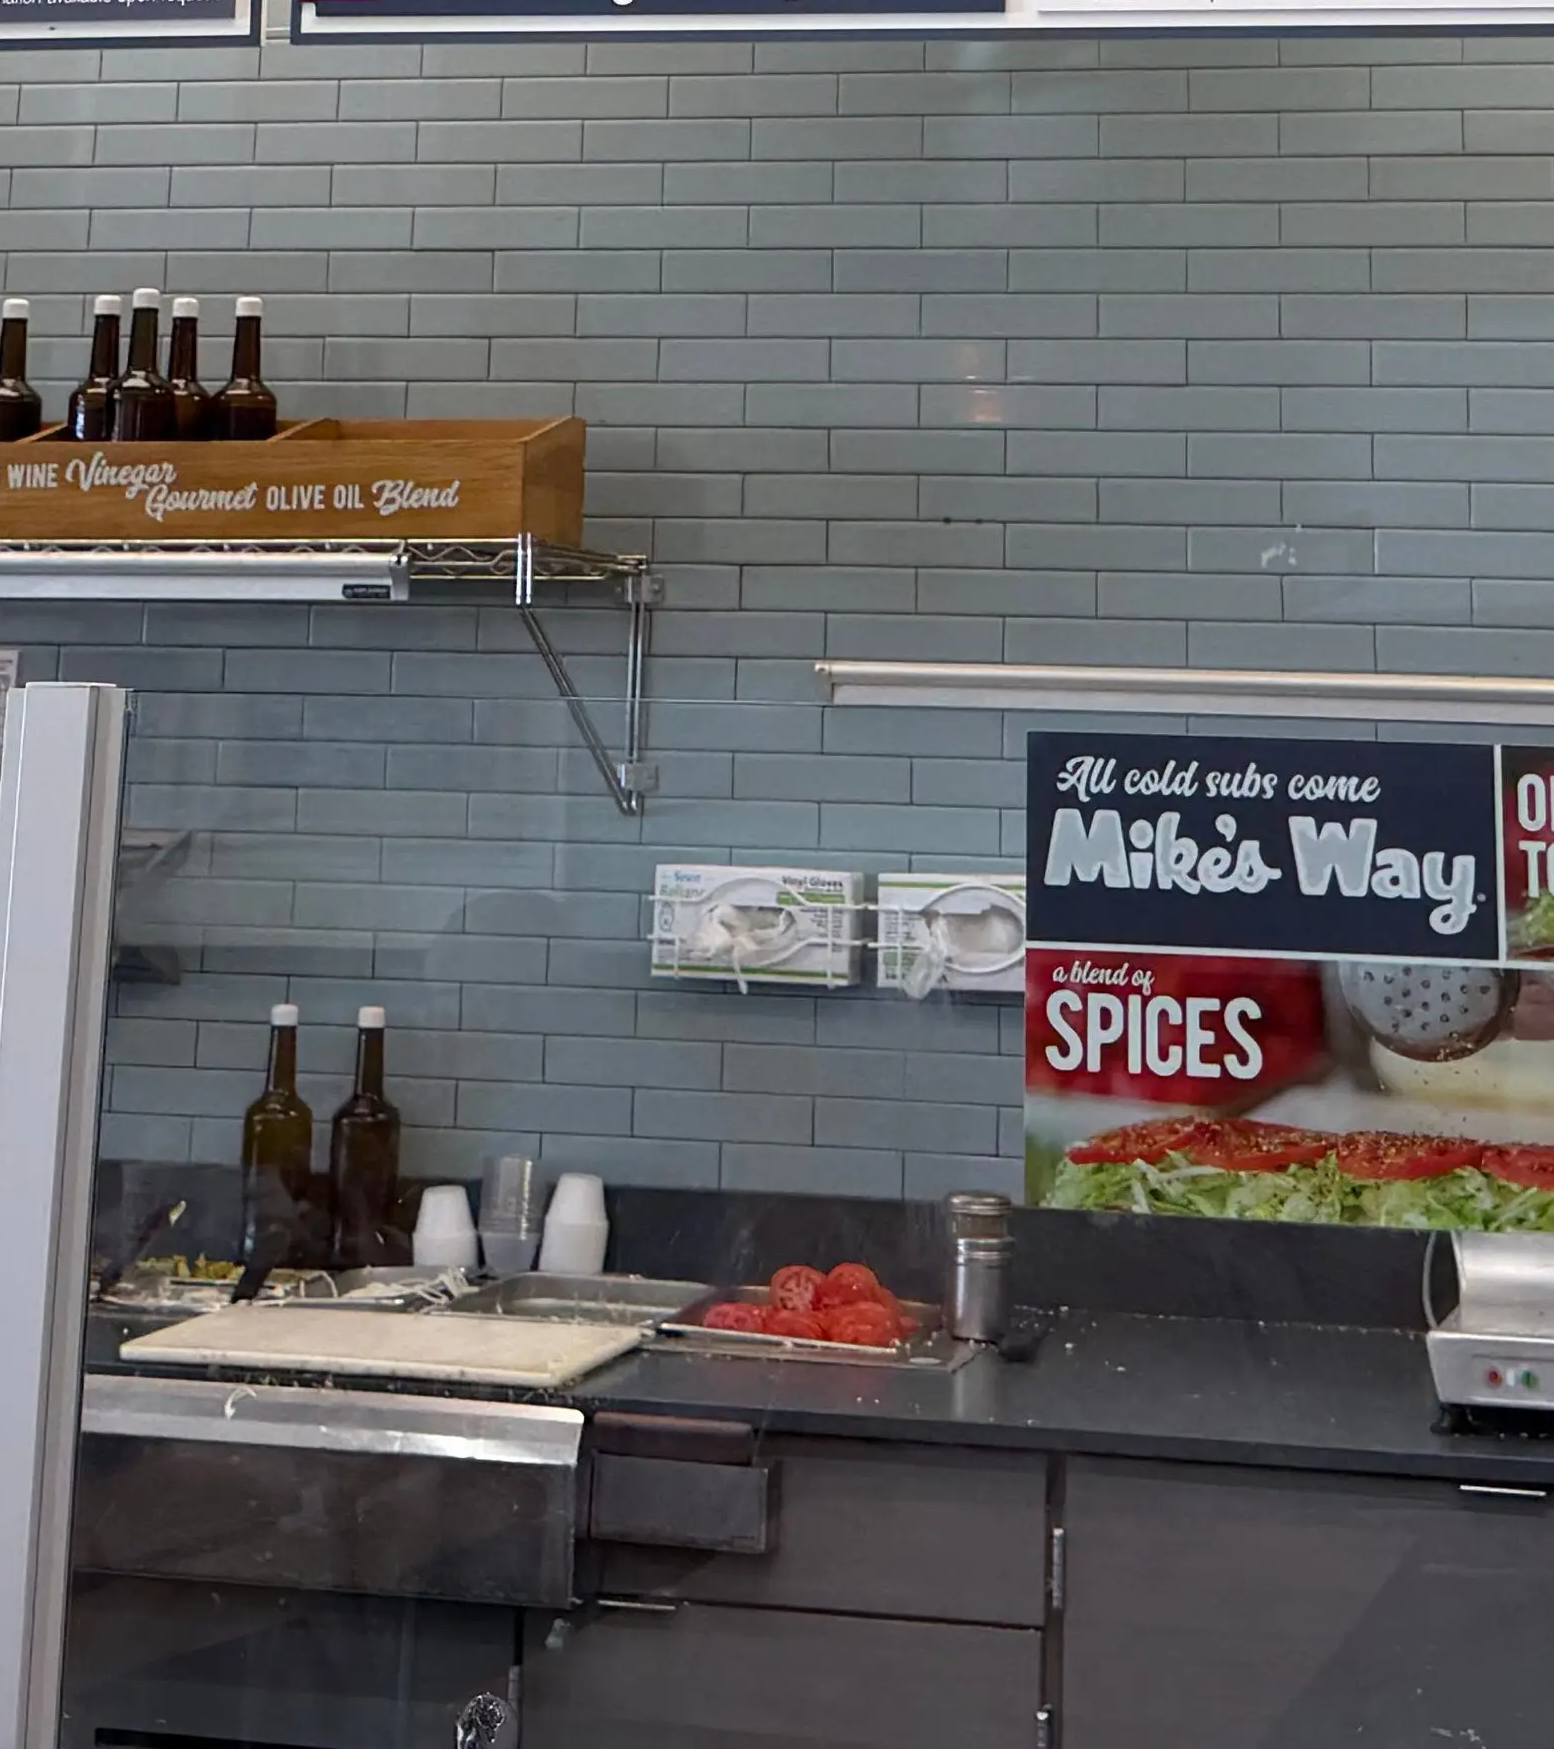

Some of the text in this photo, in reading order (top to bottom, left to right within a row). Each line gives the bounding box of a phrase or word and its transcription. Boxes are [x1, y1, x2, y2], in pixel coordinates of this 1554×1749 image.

[8, 464, 58, 488] WINE
[66, 451, 176, 498] Vinegar
[145, 480, 460, 522] Gourmet OLIVE OIL Blend
[1057, 756, 1381, 802] All cold subs come
[1044, 809, 1282, 894] Mike's
[1053, 961, 1155, 995] a blend of
[1046, 990, 1262, 1079] SPICES
